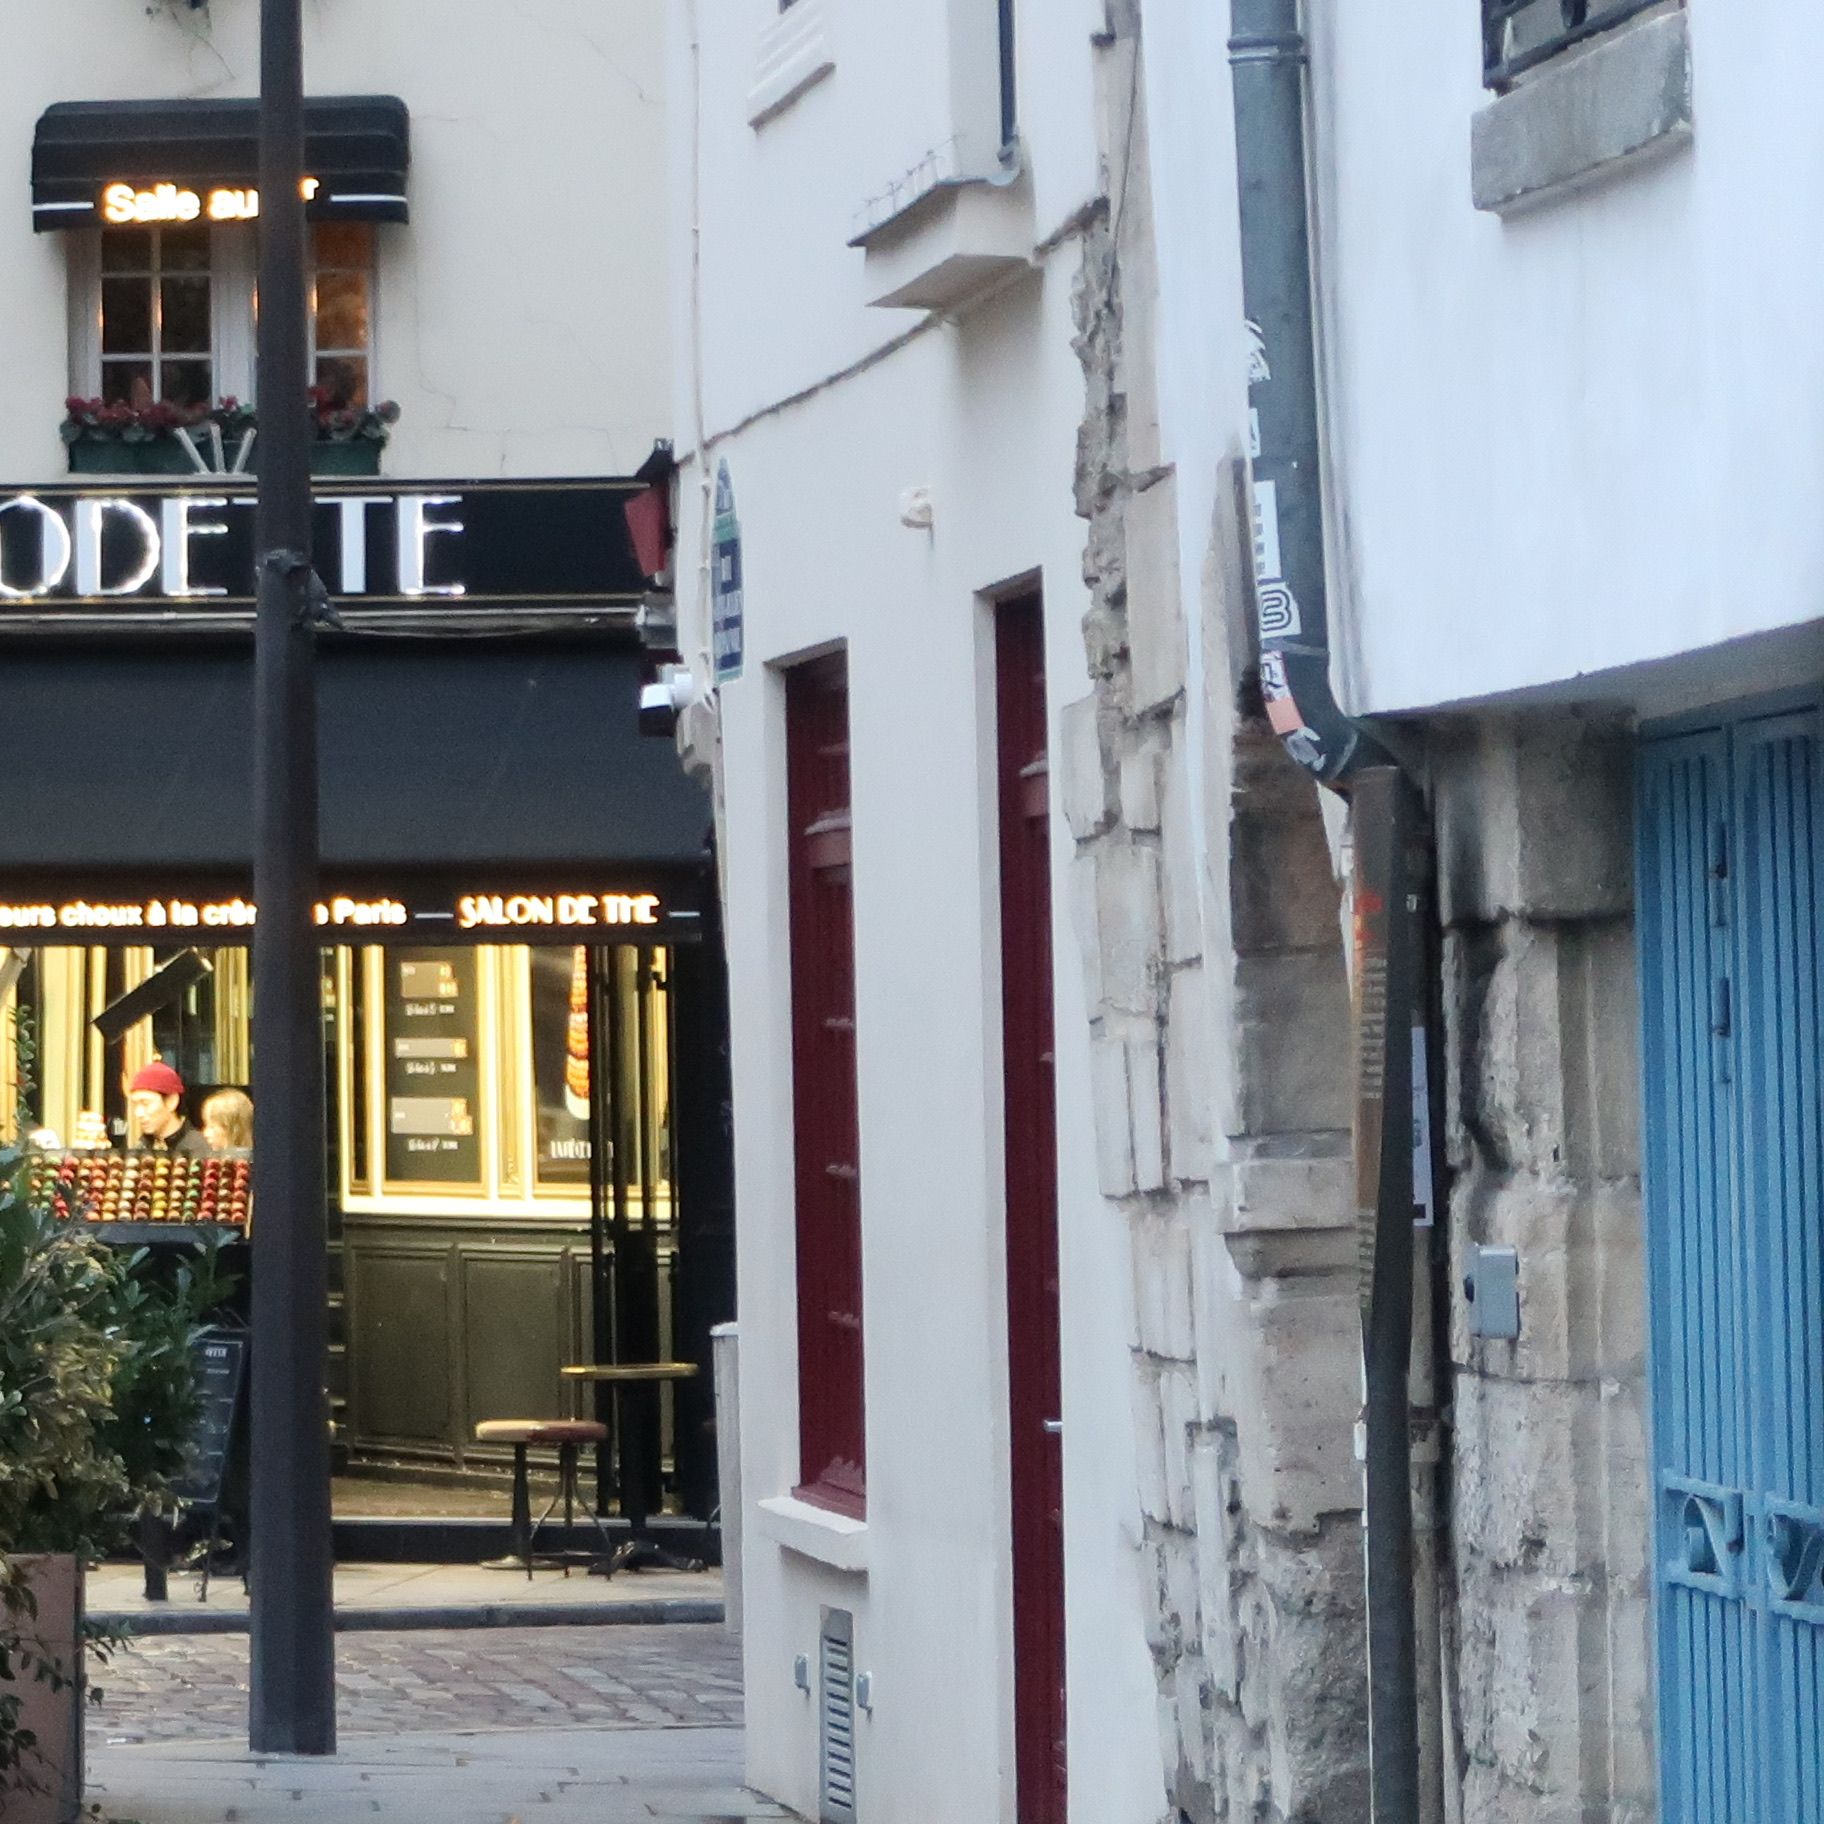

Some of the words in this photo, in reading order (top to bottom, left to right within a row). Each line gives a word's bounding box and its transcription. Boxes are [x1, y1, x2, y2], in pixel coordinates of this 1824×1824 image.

[104, 183, 201, 222] Salle
[208, 188, 259, 219] au
[60, 899, 143, 927] choux
[170, 898, 198, 926] la
[332, 897, 407, 925] Paris
[459, 895, 554, 928] SALON
[557, 895, 598, 924] DE
